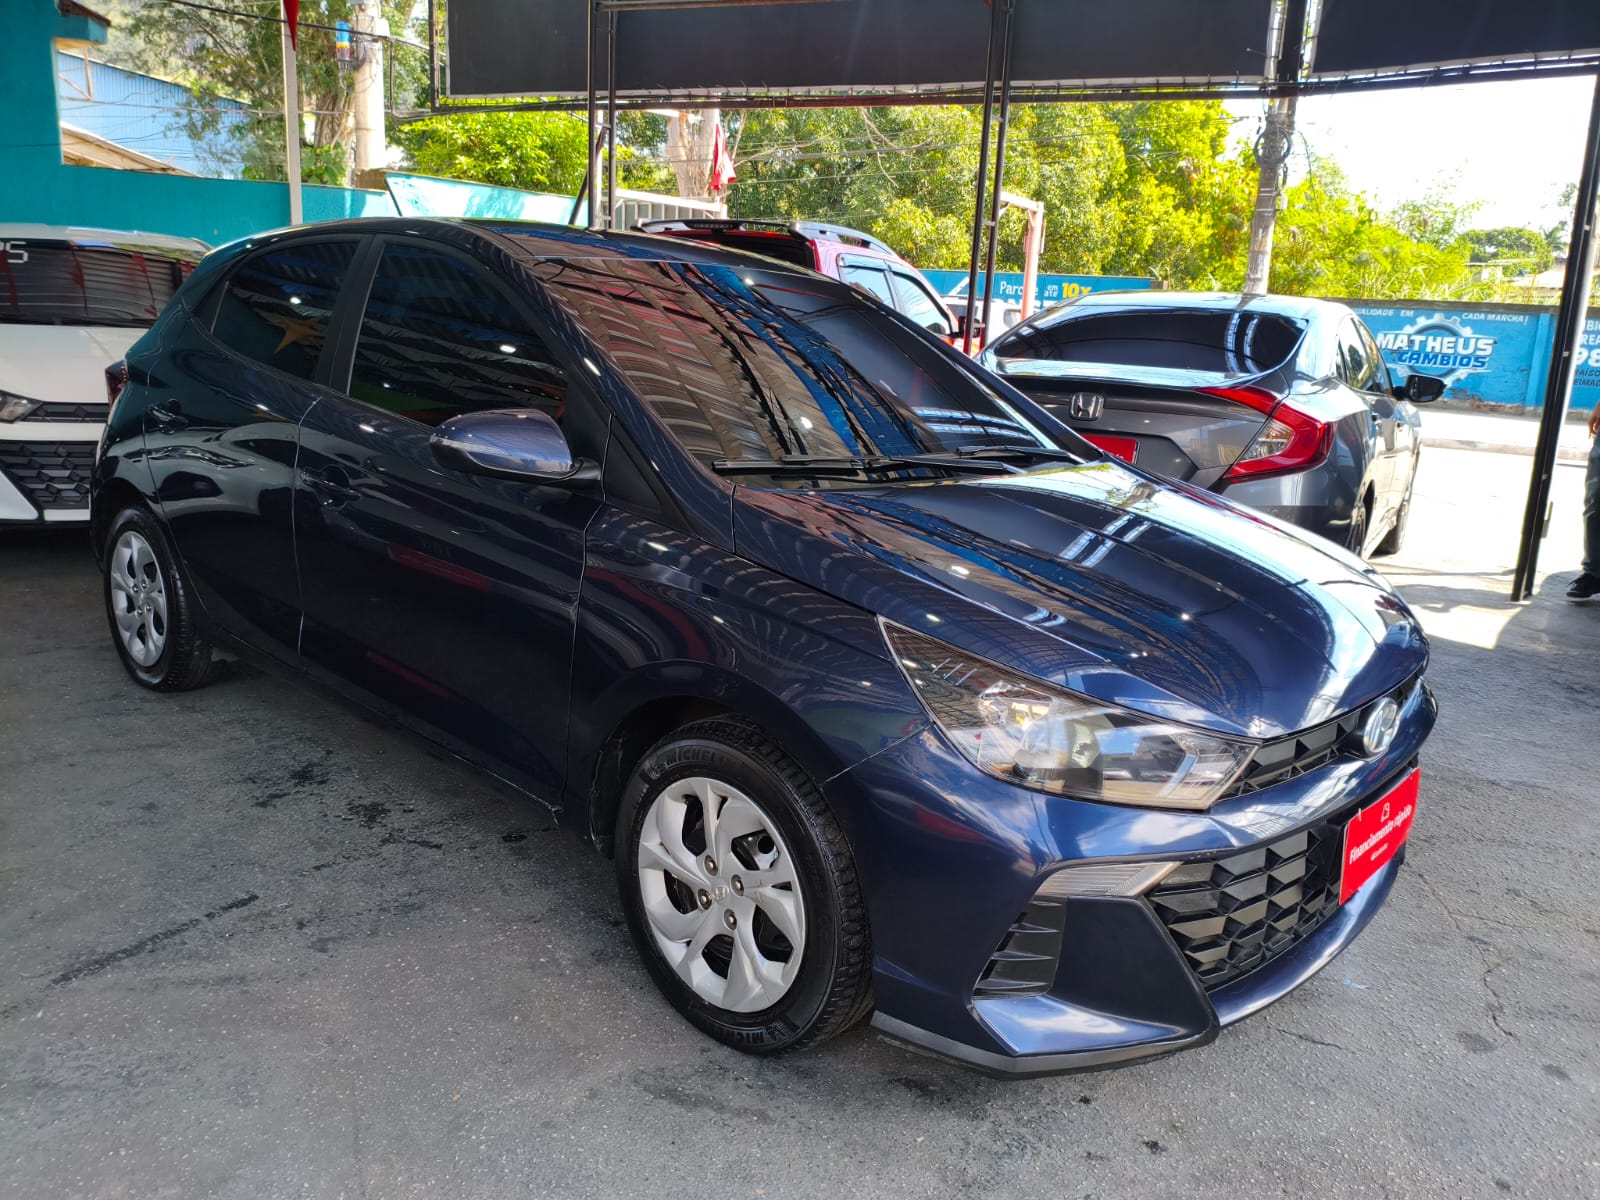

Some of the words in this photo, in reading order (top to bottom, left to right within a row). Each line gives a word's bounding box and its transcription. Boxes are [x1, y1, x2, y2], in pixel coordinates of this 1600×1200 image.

[1400, 309, 1414, 317] EM
[1462, 312, 1485, 321] CADA
[1487, 313, 1529, 326] MARCHA!
[1376, 333, 1494, 355] MATHEUS
[1397, 352, 1488, 368] CAMBIOS
